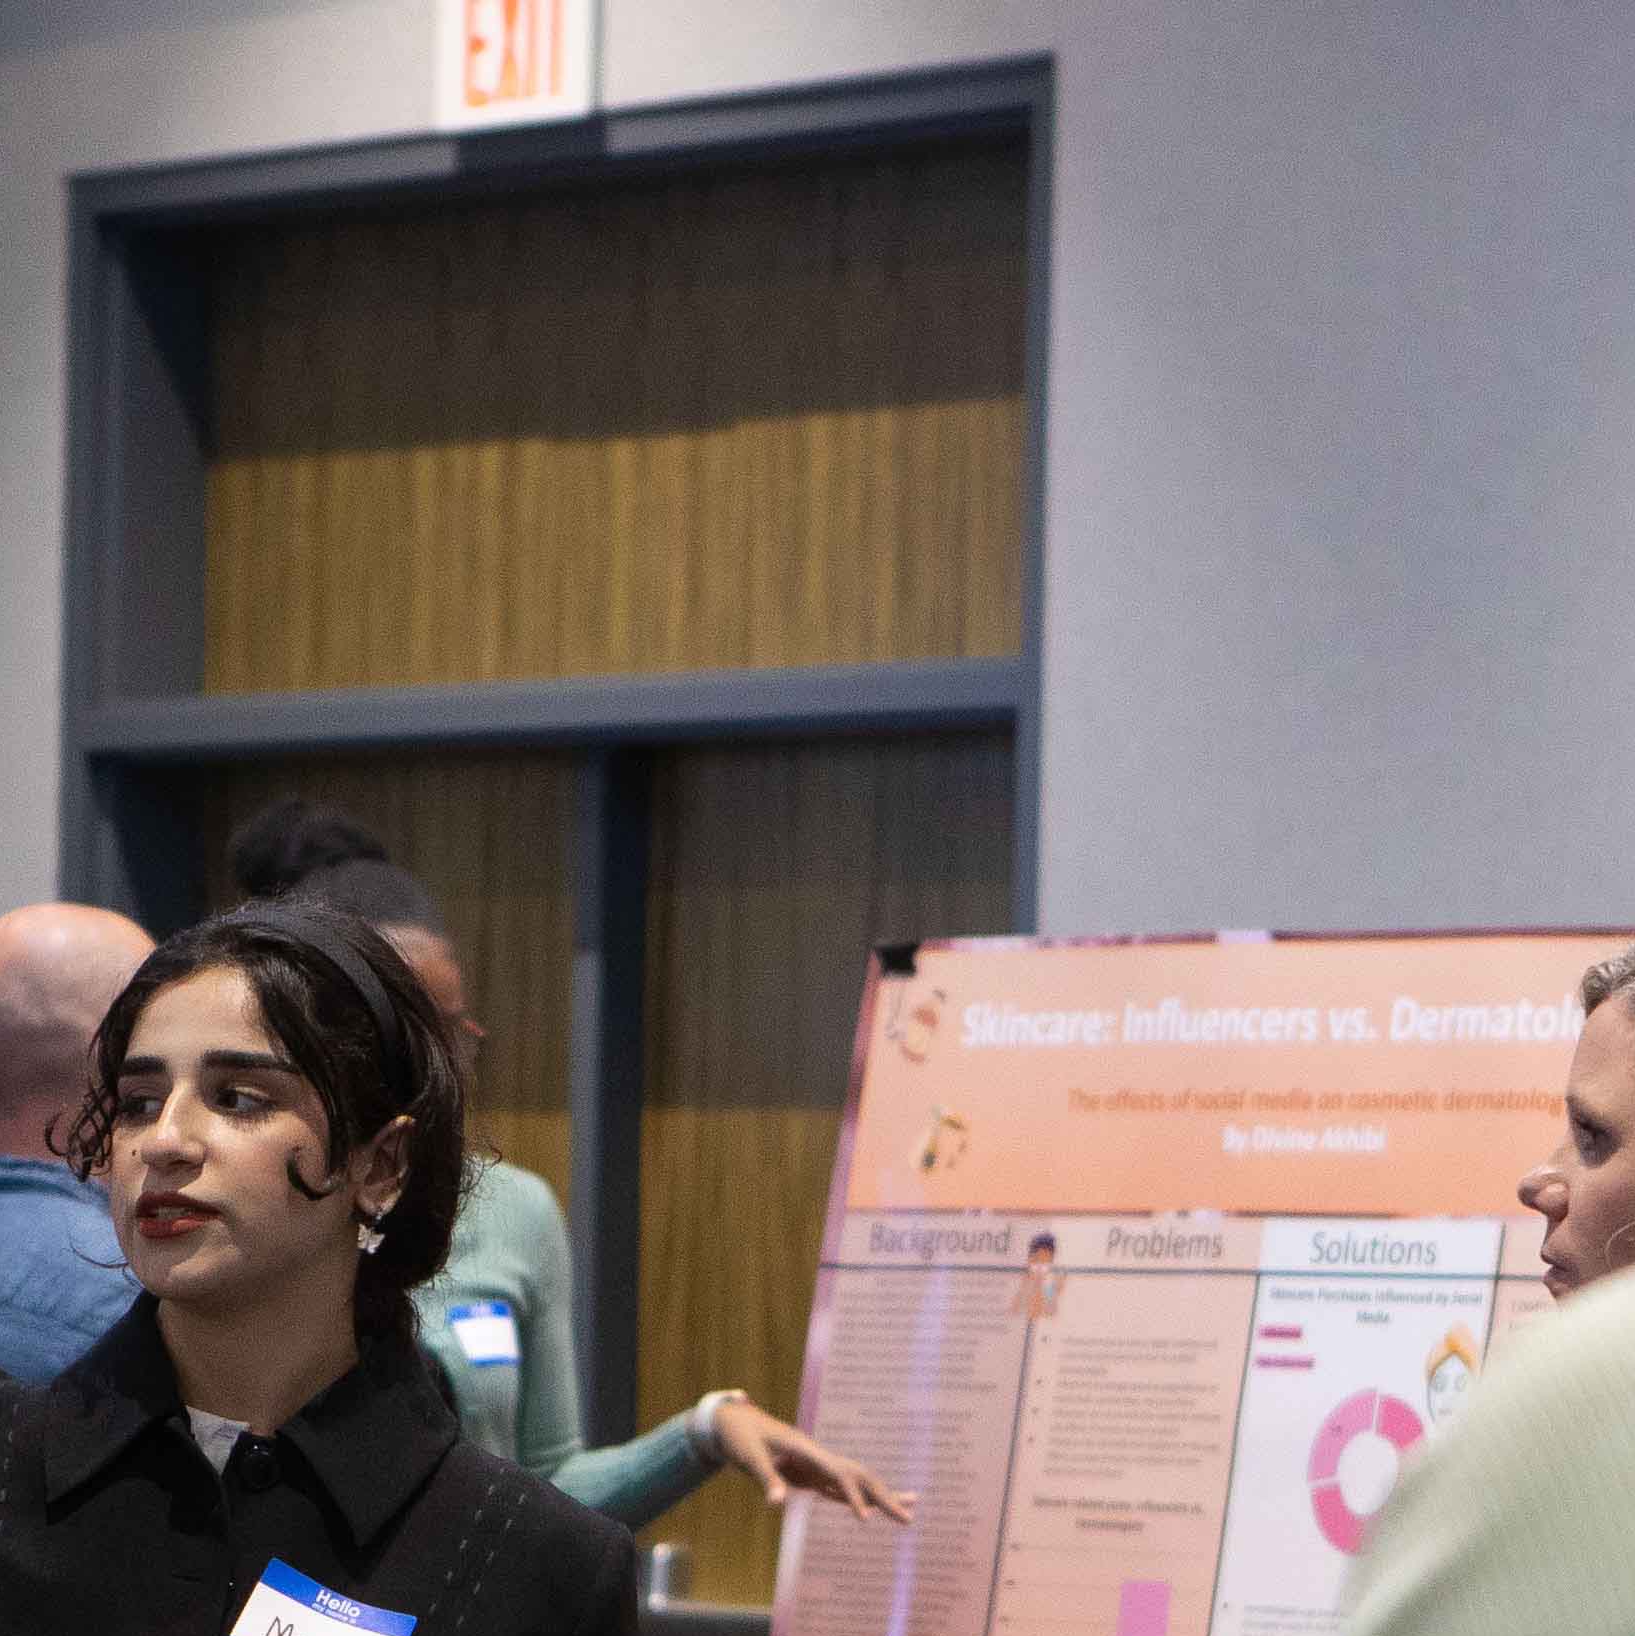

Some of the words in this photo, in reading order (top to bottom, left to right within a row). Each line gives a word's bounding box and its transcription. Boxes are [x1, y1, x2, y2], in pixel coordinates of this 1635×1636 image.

[960, 1002, 1117, 1048] Skincare:
[1121, 996, 1317, 1044] Influencers
[1326, 1005, 1377, 1043] vs.
[868, 1223, 1012, 1262] Background
[1105, 1225, 1223, 1261] Problems
[1308, 1230, 1437, 1266] Solutions
[315, 1589, 361, 1618] Hello
